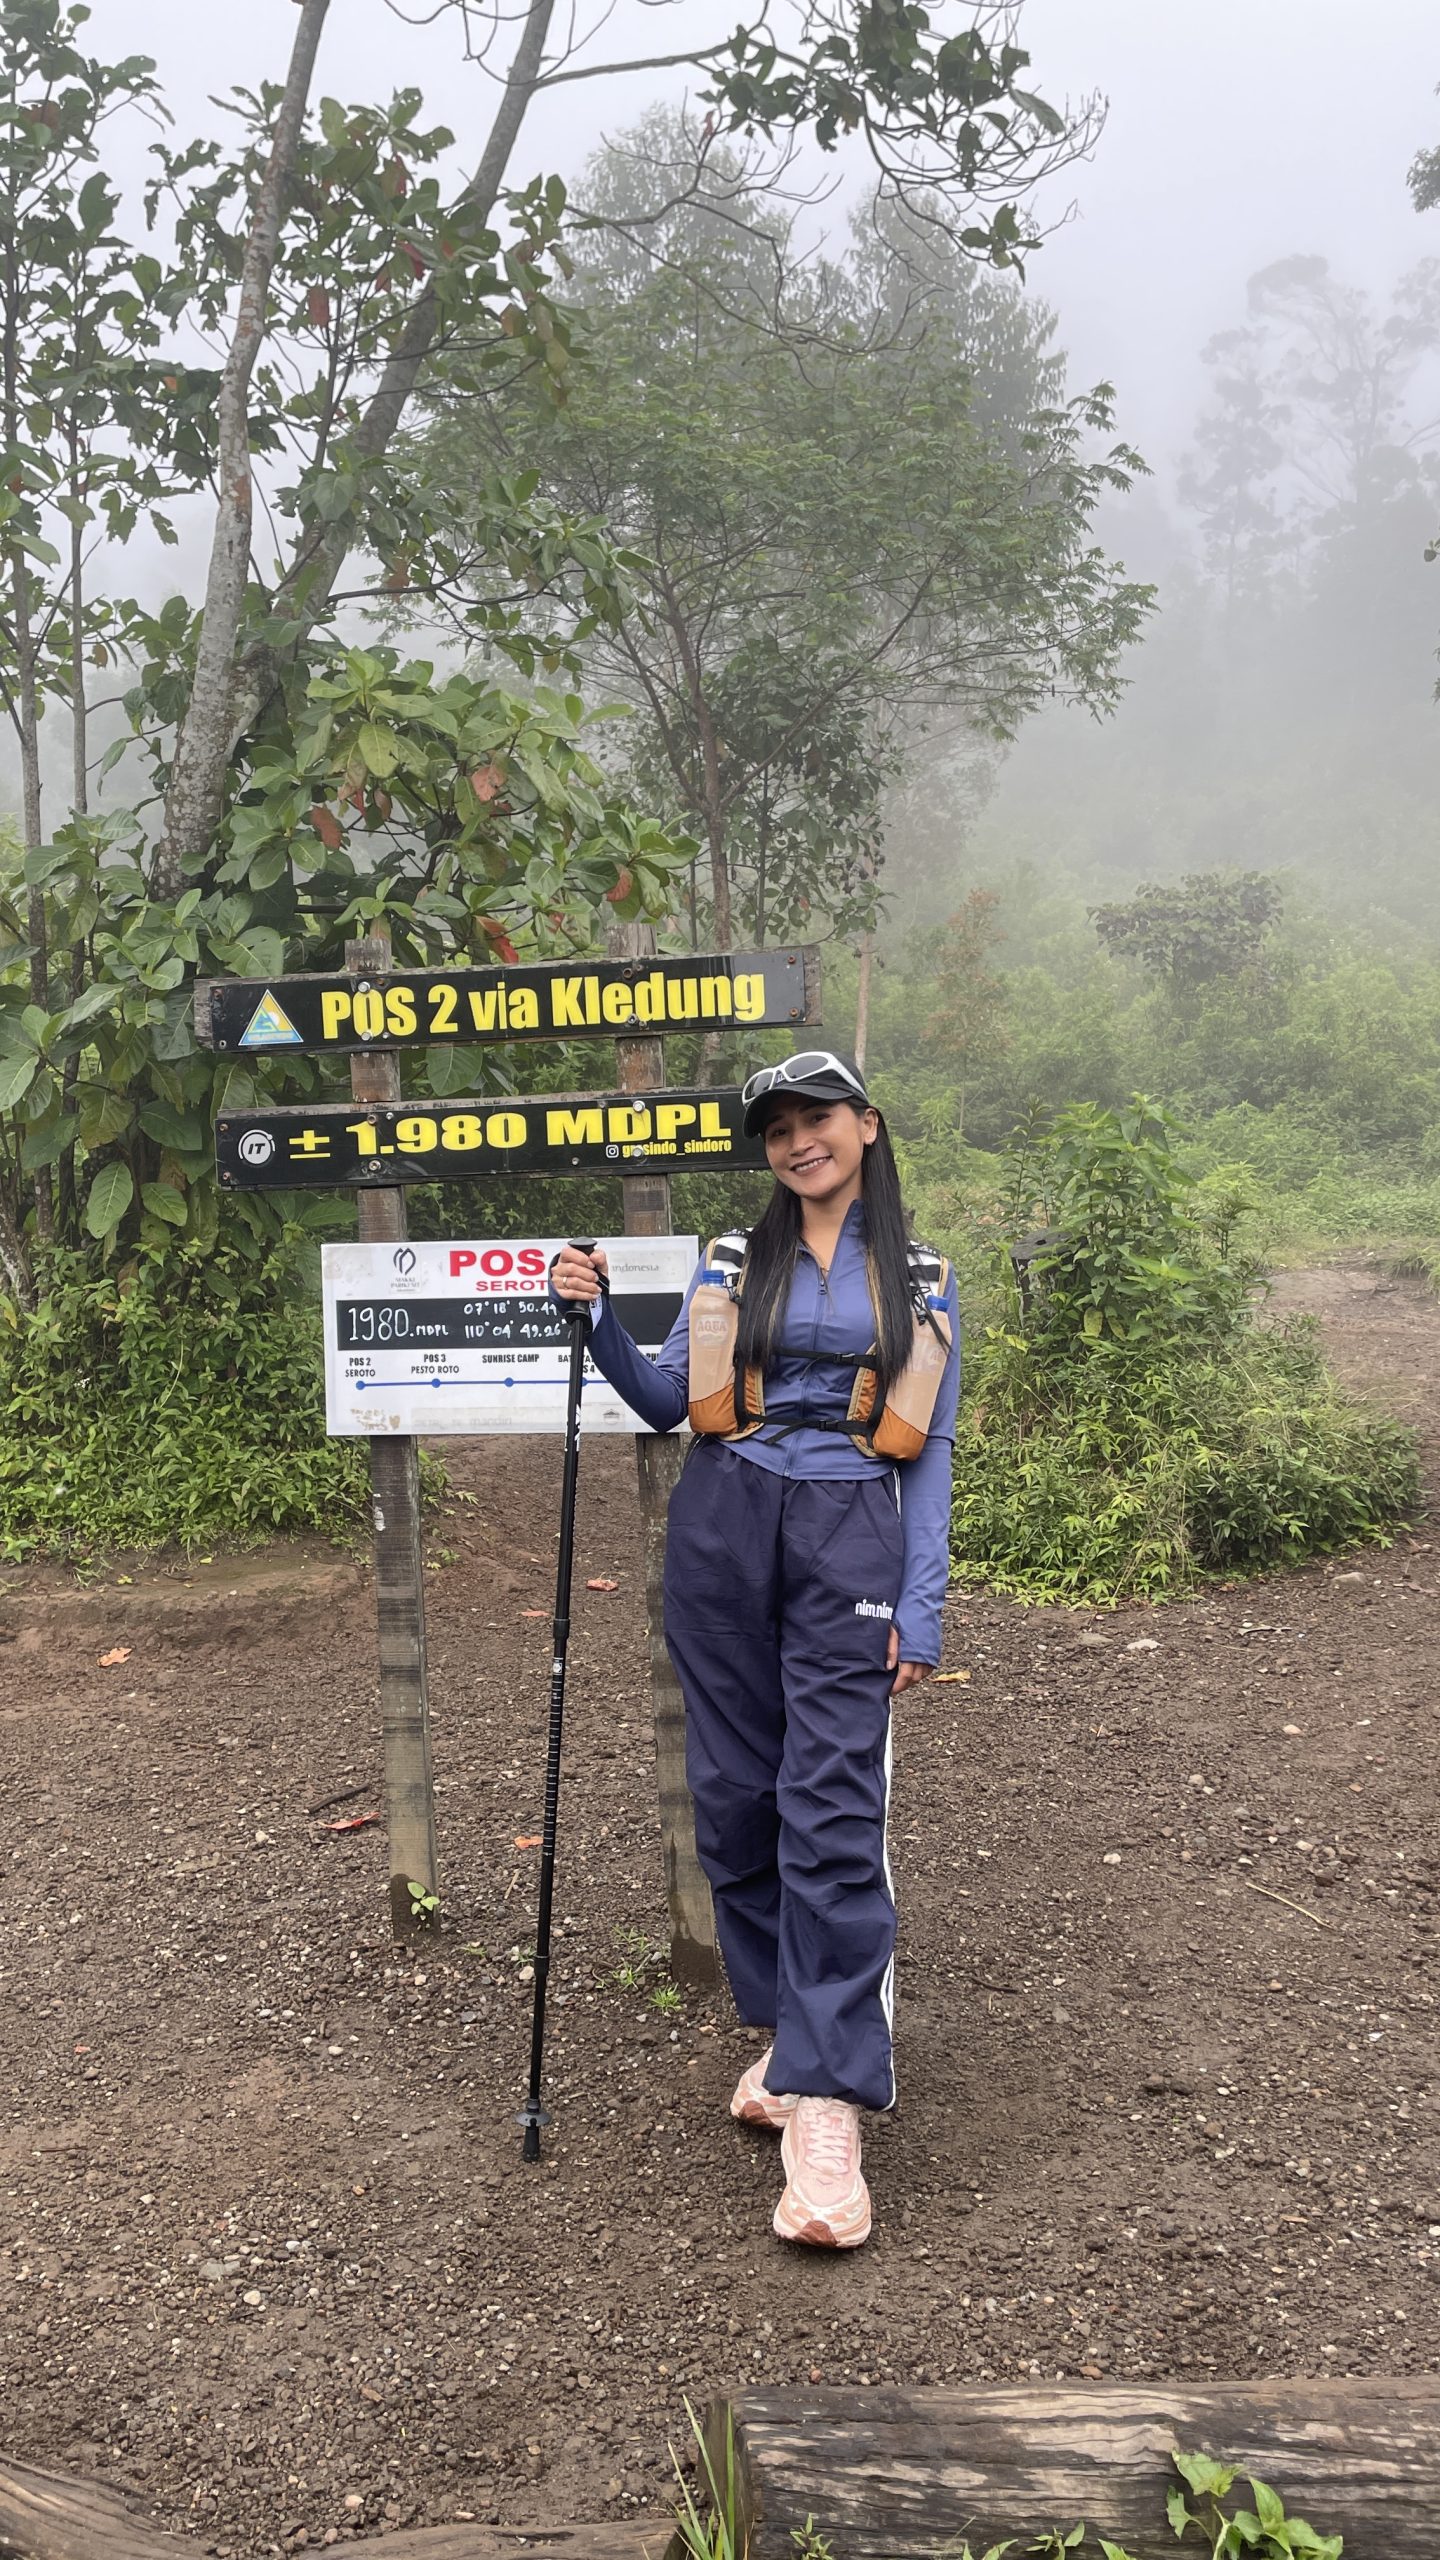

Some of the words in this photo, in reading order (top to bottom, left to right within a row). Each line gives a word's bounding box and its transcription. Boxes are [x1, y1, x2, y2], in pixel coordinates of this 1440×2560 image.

[321, 987, 418, 1040] POS
[428, 984, 459, 1034] 2
[468, 981, 539, 1031] via
[550, 971, 766, 1027] Kledung
[348, 1112, 527, 1155] 1.980
[547, 1102, 732, 1146] MDPL
[248, 1143, 266, 1155] IT
[622, 1139, 732, 1158] grsindo_sindoro
[449, 1248, 546, 1278] POS
[475, 1280, 549, 1292] SEROT
[697, 1319, 728, 1335] AQUA
[348, 1357, 364, 1367] POS
[365, 1357, 372, 1366] 2
[423, 1353, 439, 1363] POS
[440, 1353, 446, 1363] 3
[481, 1354, 516, 1364] SUNRISE
[517, 1353, 540, 1363] CAMP
[344, 1369, 376, 1378] SEROTO
[411, 1365, 435, 1374] PESTO
[437, 1365, 460, 1374] ROTO
[854, 1598, 894, 1621] nim.nim
